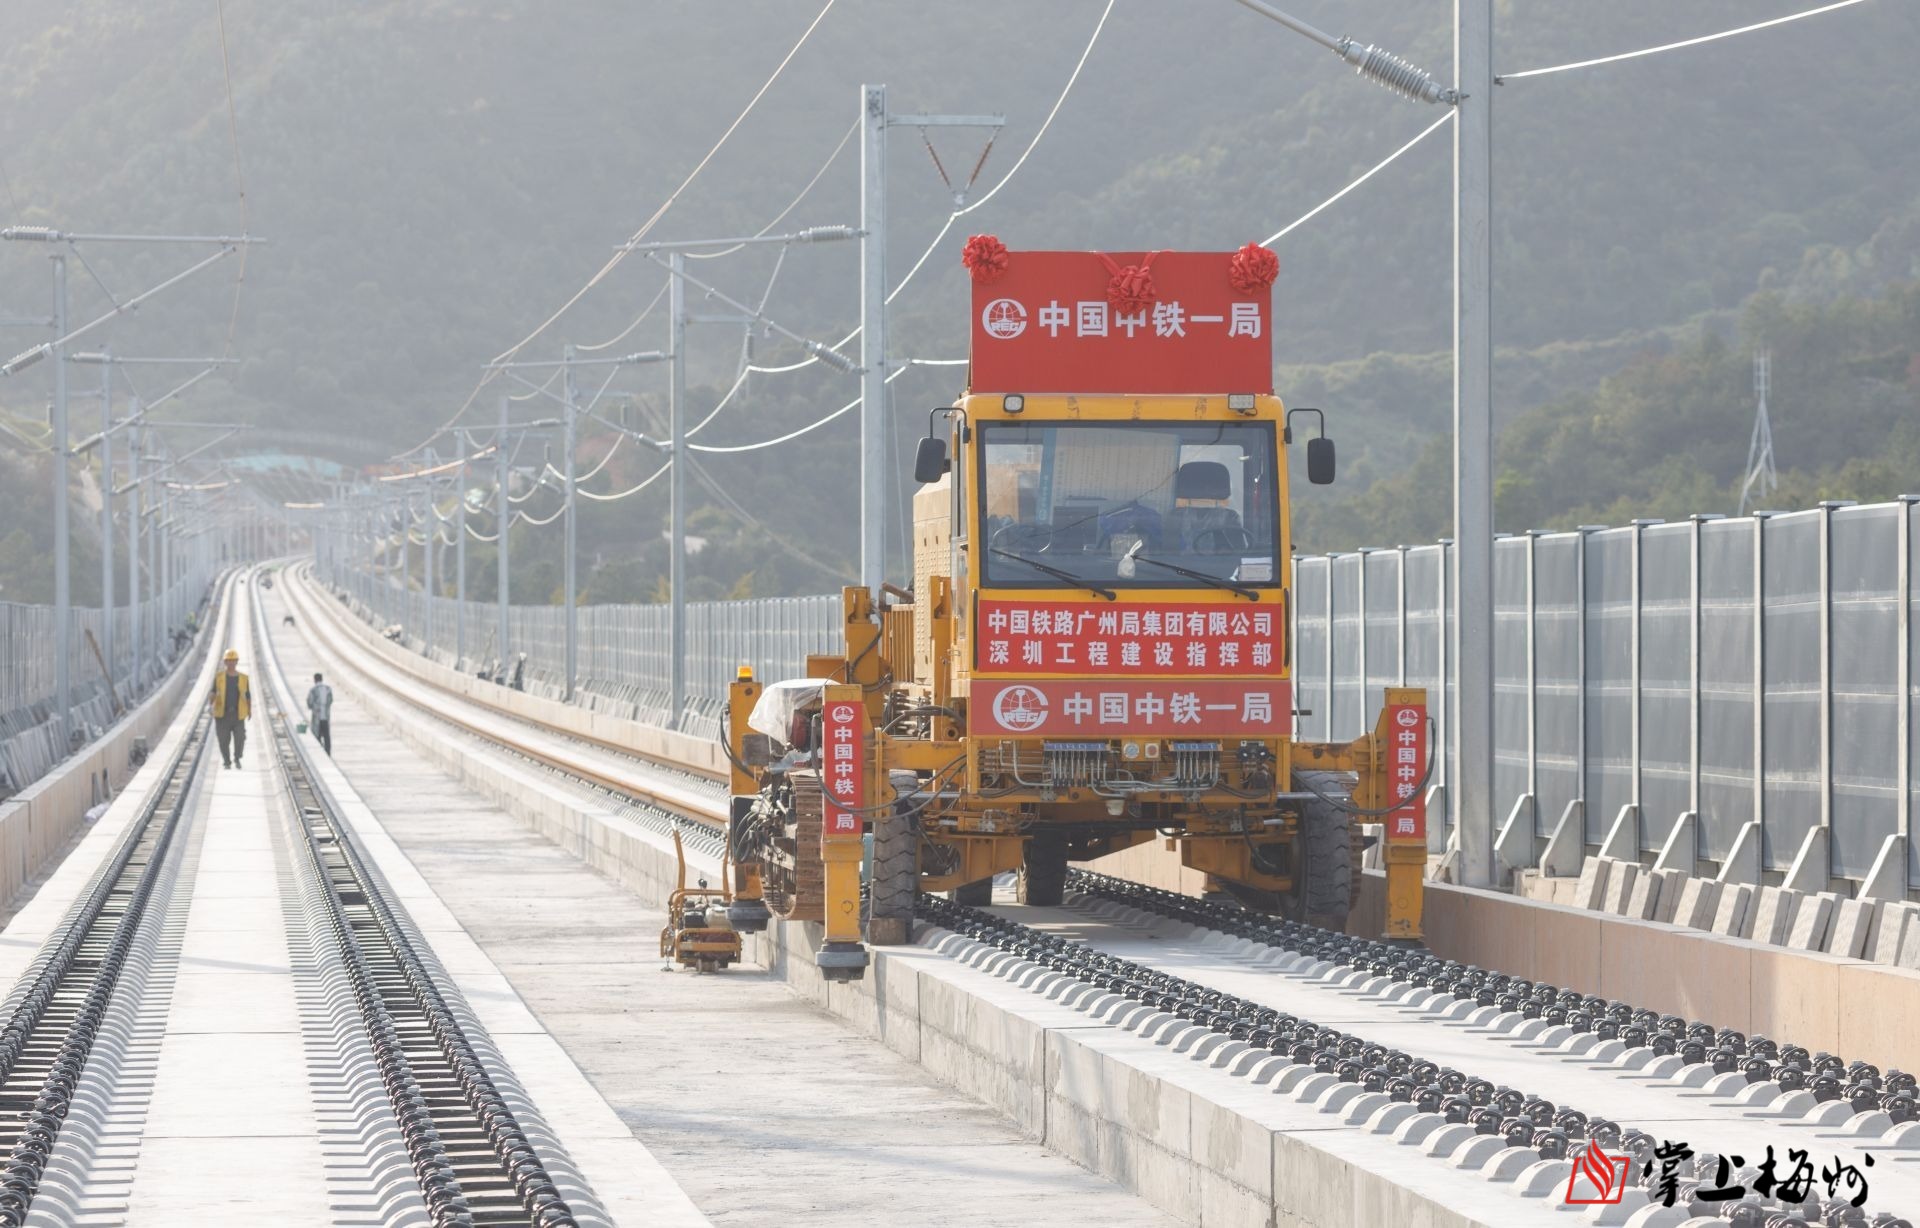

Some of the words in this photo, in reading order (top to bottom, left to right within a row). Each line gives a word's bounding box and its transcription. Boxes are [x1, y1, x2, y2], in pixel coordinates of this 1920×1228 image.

[987, 609, 1272, 637] 中国铁路广州局集团有限公司
[989, 640, 1272, 667] 深圳工程建设指挥部
[1063, 692, 1272, 724] 中国中铁一局
[834, 726, 855, 830] 中国中铁一局
[1396, 730, 1416, 834] 中国中铁一局
